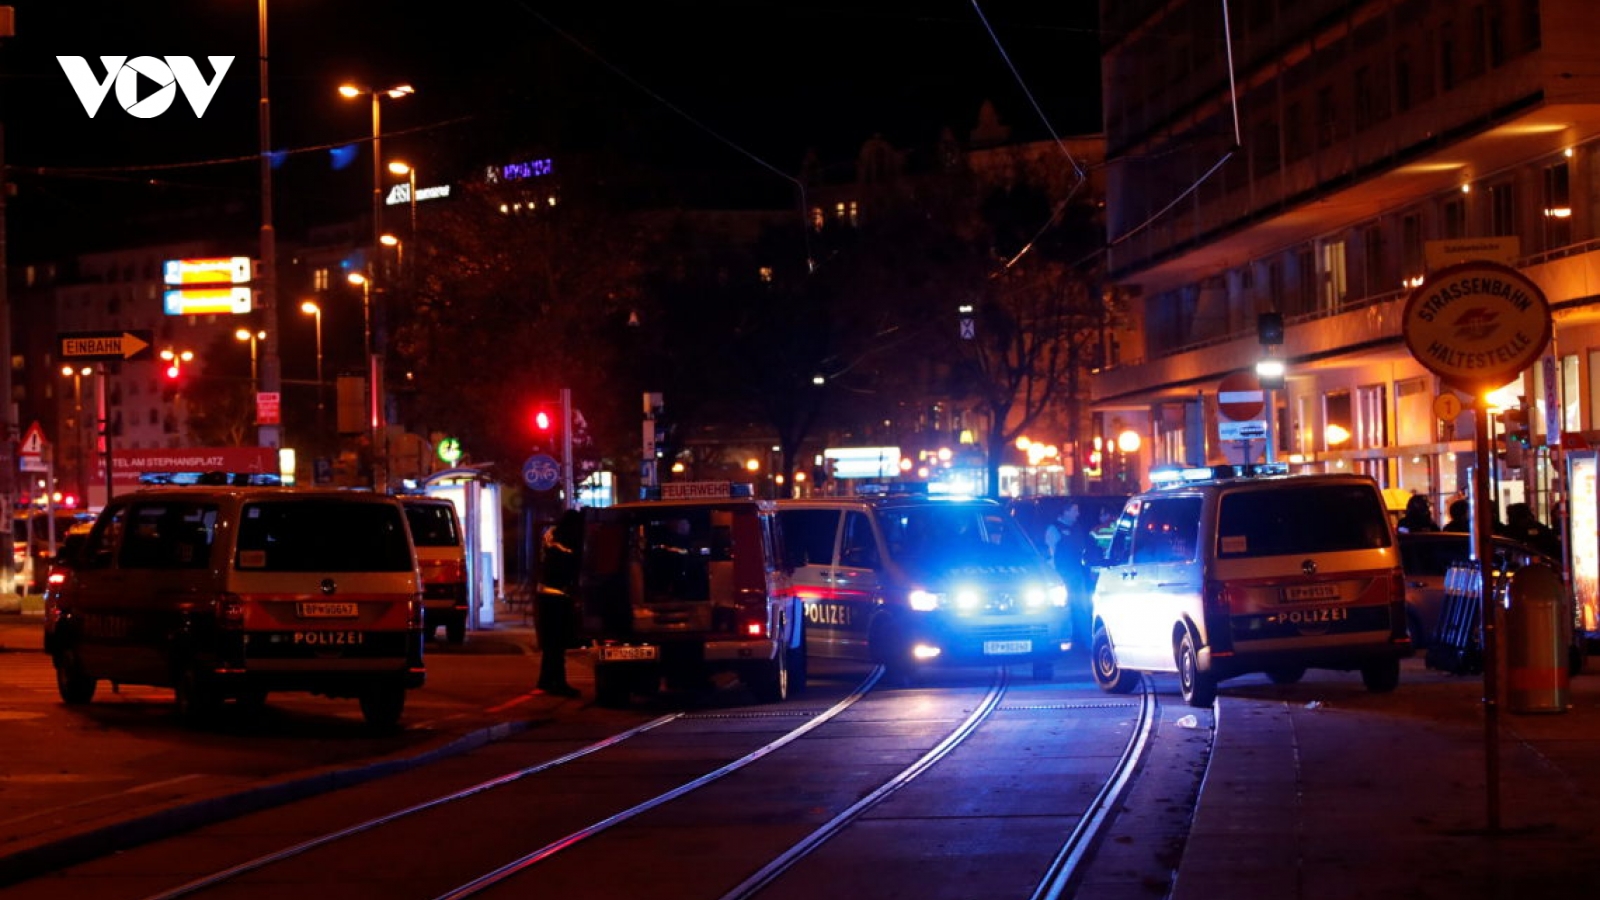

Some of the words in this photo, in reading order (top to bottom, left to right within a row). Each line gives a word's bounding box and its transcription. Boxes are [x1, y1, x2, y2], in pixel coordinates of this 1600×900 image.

[1418, 277, 1533, 322] STRASSENBAHN
[66, 340, 122, 354] EINBAHN
[1426, 330, 1529, 368] HALTESTELLE
[97, 458, 128, 468] HTEL
[146, 456, 224, 467] STEPHANSPLATZ
[662, 483, 729, 497] FEUERWEHR
[1279, 608, 1347, 624] POLIZEI
[294, 631, 362, 645] POLIZEI
